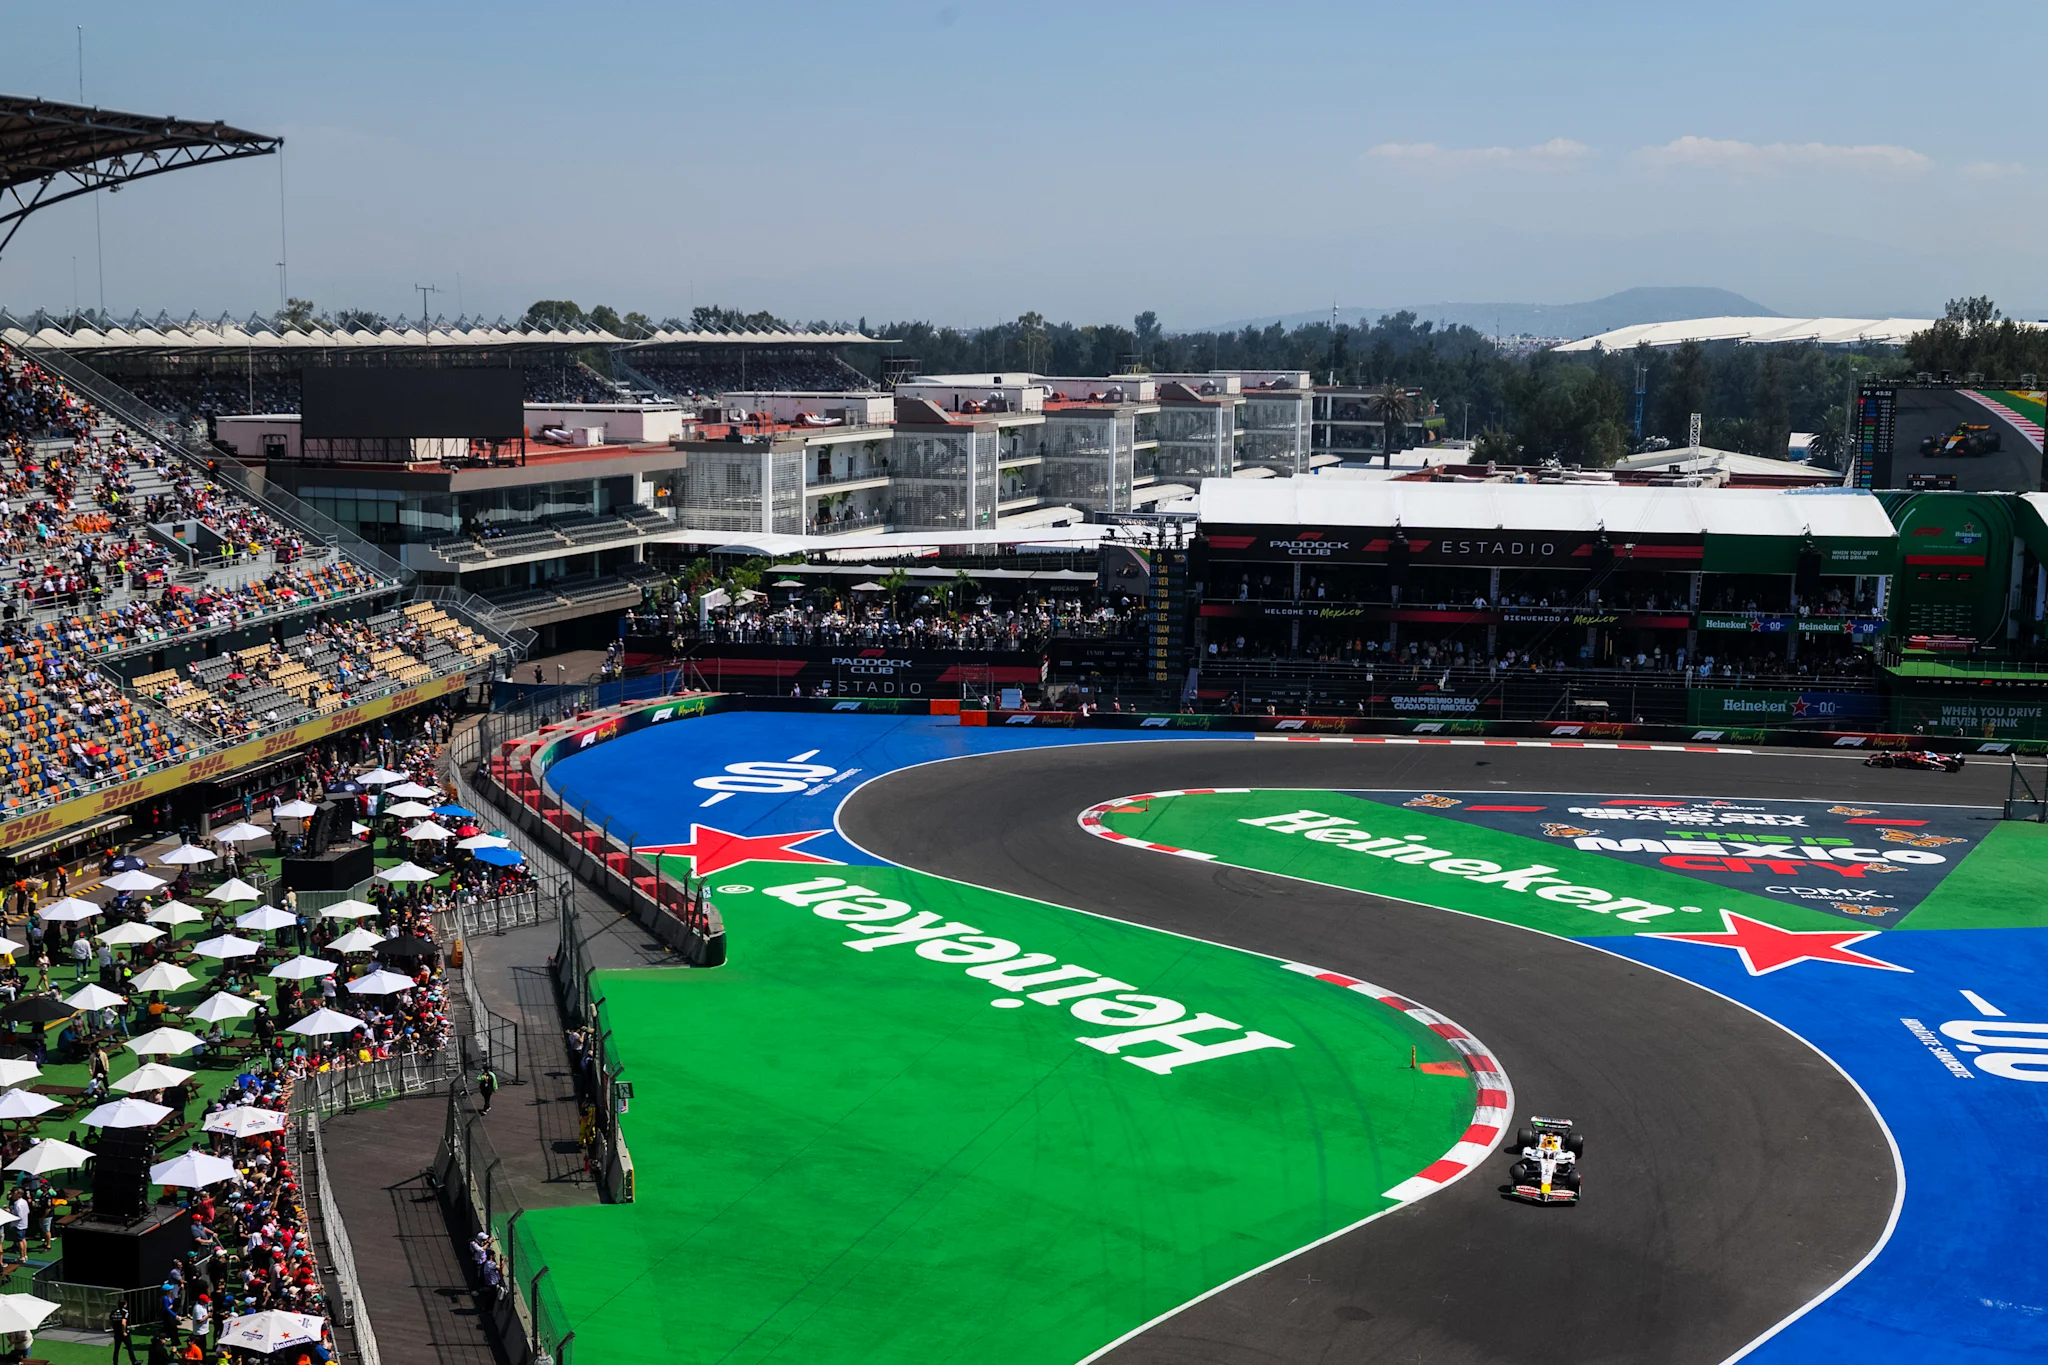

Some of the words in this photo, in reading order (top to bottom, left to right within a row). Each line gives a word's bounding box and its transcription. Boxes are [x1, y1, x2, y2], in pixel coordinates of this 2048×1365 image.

[1270, 540, 1350, 549] PADDOCK
[1442, 541, 1554, 555] ESTADIO
[1156, 552, 1163, 564] 8
[1157, 613, 1168, 622] LEC
[1320, 608, 1364, 619] Mexico
[1573, 614, 1619, 625] Mexico
[1706, 620, 1746, 629] Heineken
[1799, 622, 1839, 631] Heineken
[832, 657, 912, 668] PADDOCK
[850, 666, 894, 675] CLUB
[822, 680, 922, 695] ESTADIO
[392, 689, 419, 710] DHL
[1723, 699, 1786, 712] Heineken
[1941, 706, 1976, 716] WHEN
[1980, 706, 2004, 717] YOU
[2008, 707, 2042, 717] DRIVE
[331, 708, 362, 730] DHL
[1312, 720, 1332, 730] Mexico
[1941, 716, 1978, 726] NEVER
[1451, 723, 1471, 733] Mexico
[1589, 726, 1610, 736] Mexico
[264, 730, 298, 754] DHL
[1730, 732, 1752, 742] Mexico
[1873, 737, 1894, 748] Mexico
[188, 754, 226, 780] DHL
[102, 781, 146, 809] DHL
[1567, 807, 1715, 818] MEXICO
[1721, 813, 1806, 823] CITY
[1582, 813, 1713, 822] GRAND
[1718, 817, 1810, 827] PRIX
[4, 812, 52, 844] DHL
[1665, 830, 1798, 844] THIS
[1800, 836, 1854, 846] IS
[1574, 836, 1946, 864] MEXICO
[1237, 809, 1675, 924] Heineken
[1659, 856, 1868, 878] CITY
[762, 876, 1295, 1075] Heineken
[274, 1337, 310, 1350] Heineken
